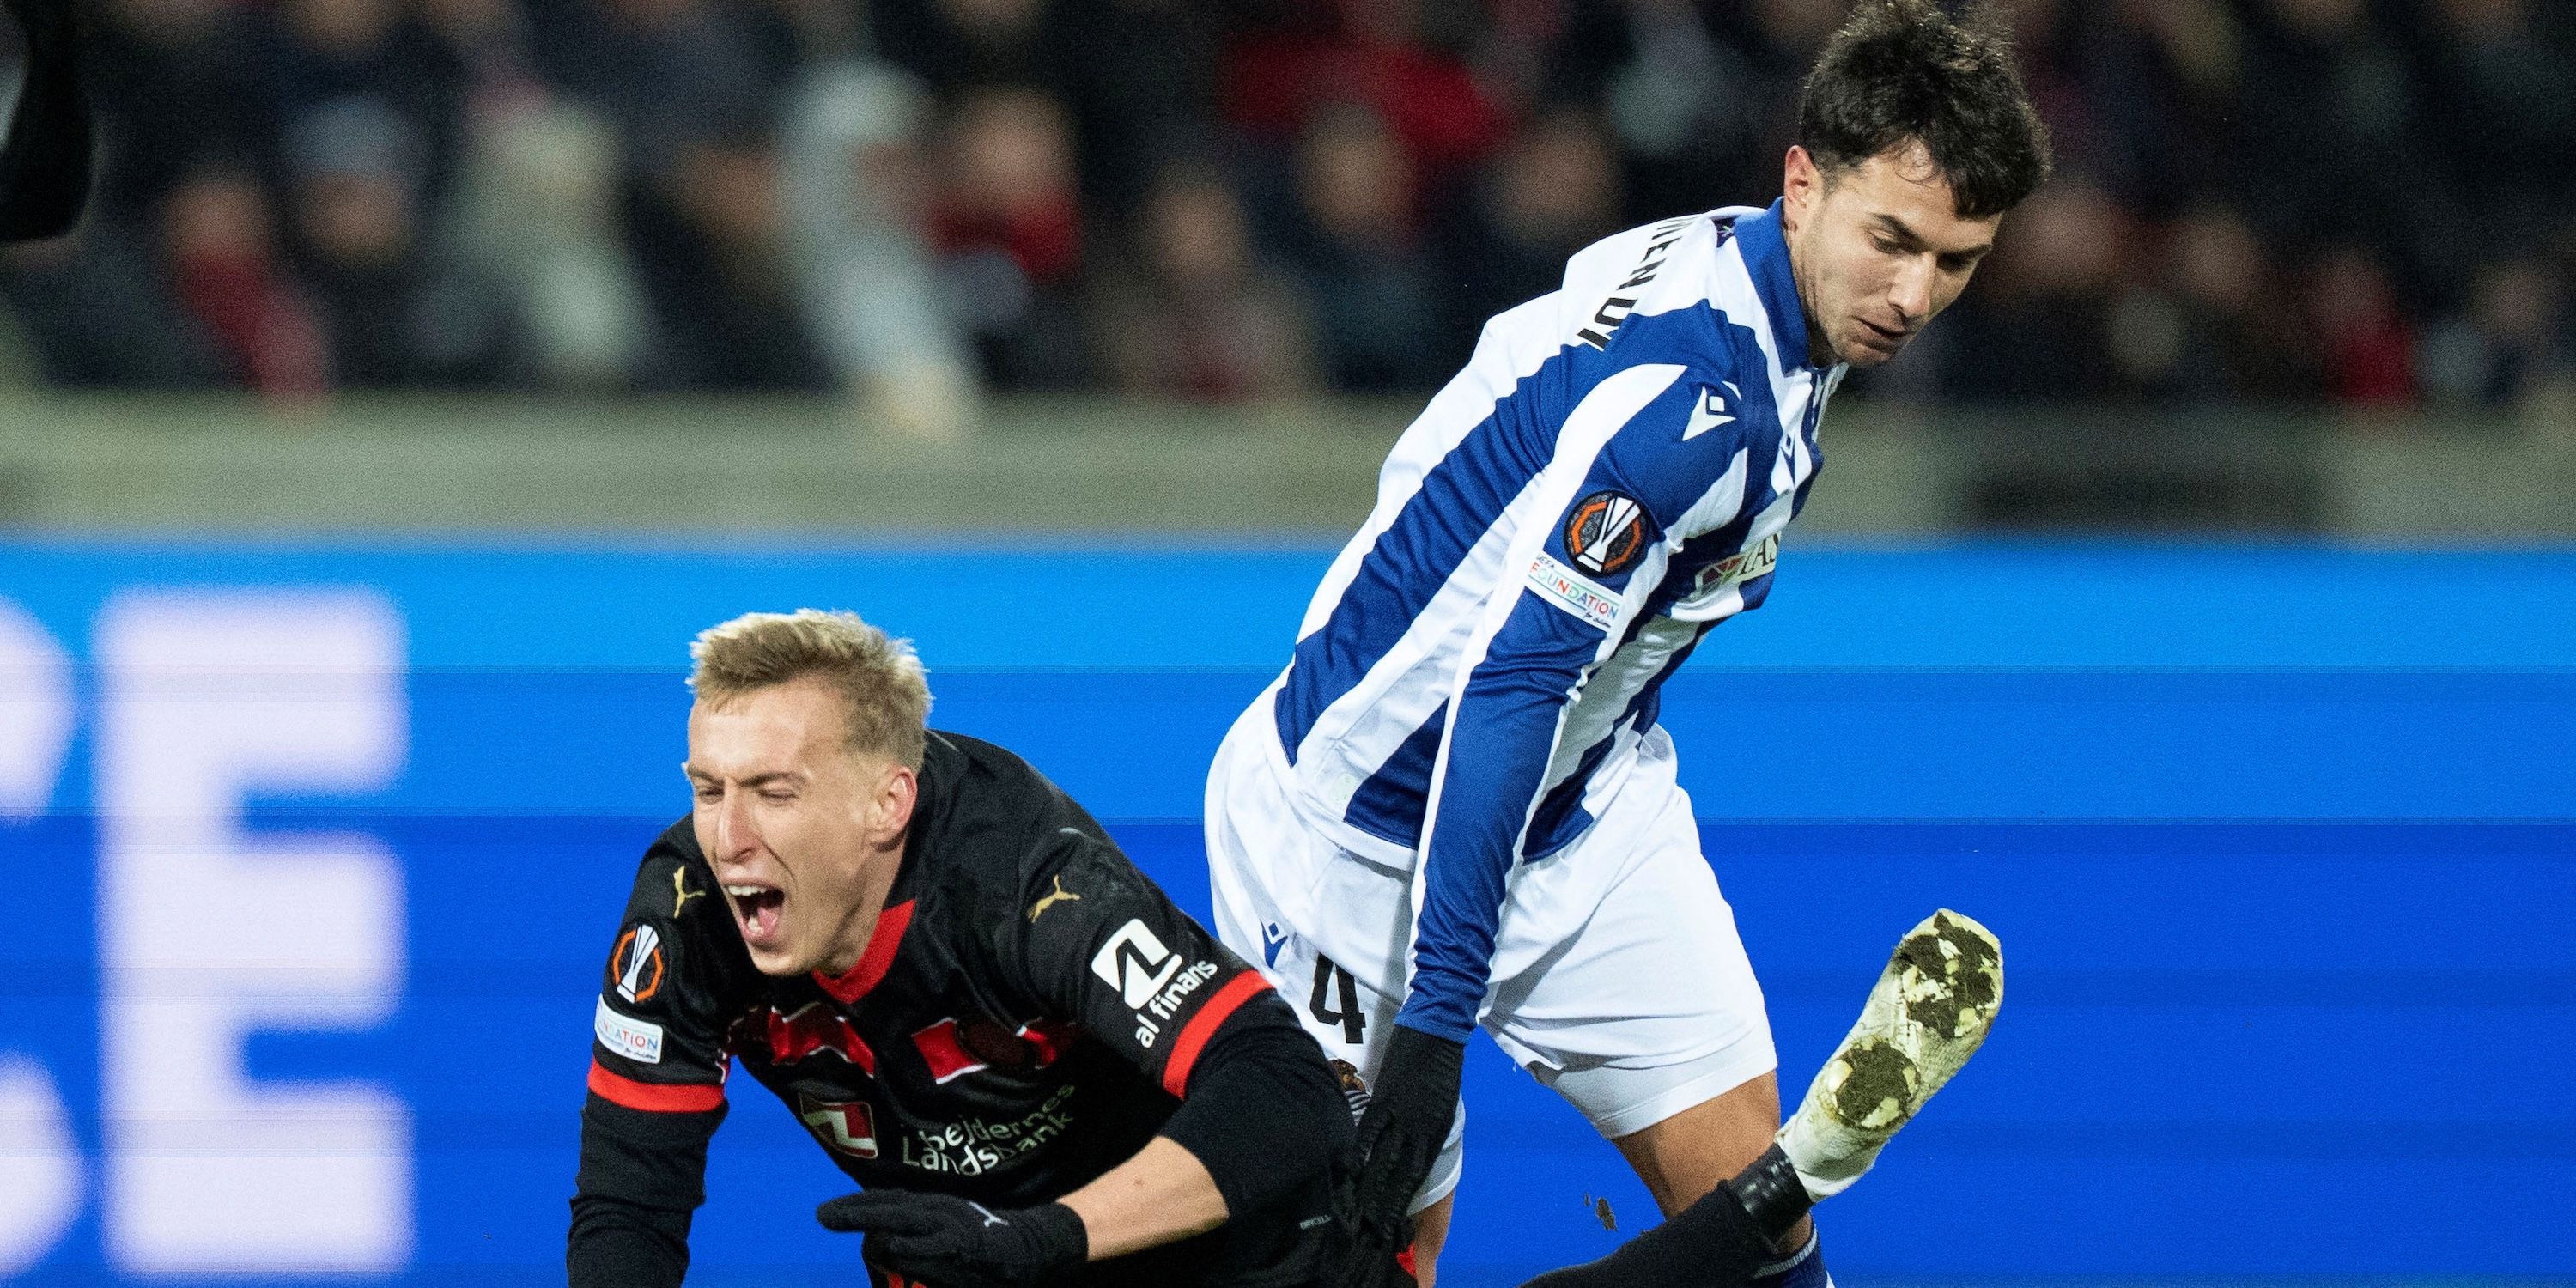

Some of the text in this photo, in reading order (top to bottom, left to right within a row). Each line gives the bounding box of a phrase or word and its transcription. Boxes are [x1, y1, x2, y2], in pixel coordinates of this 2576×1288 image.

[1529, 562, 1619, 620] FOUNDATION
[1135, 960, 1218, 1048] al finans
[1309, 951, 1366, 1044] 4
[918, 1085, 1075, 1151] bejdernes
